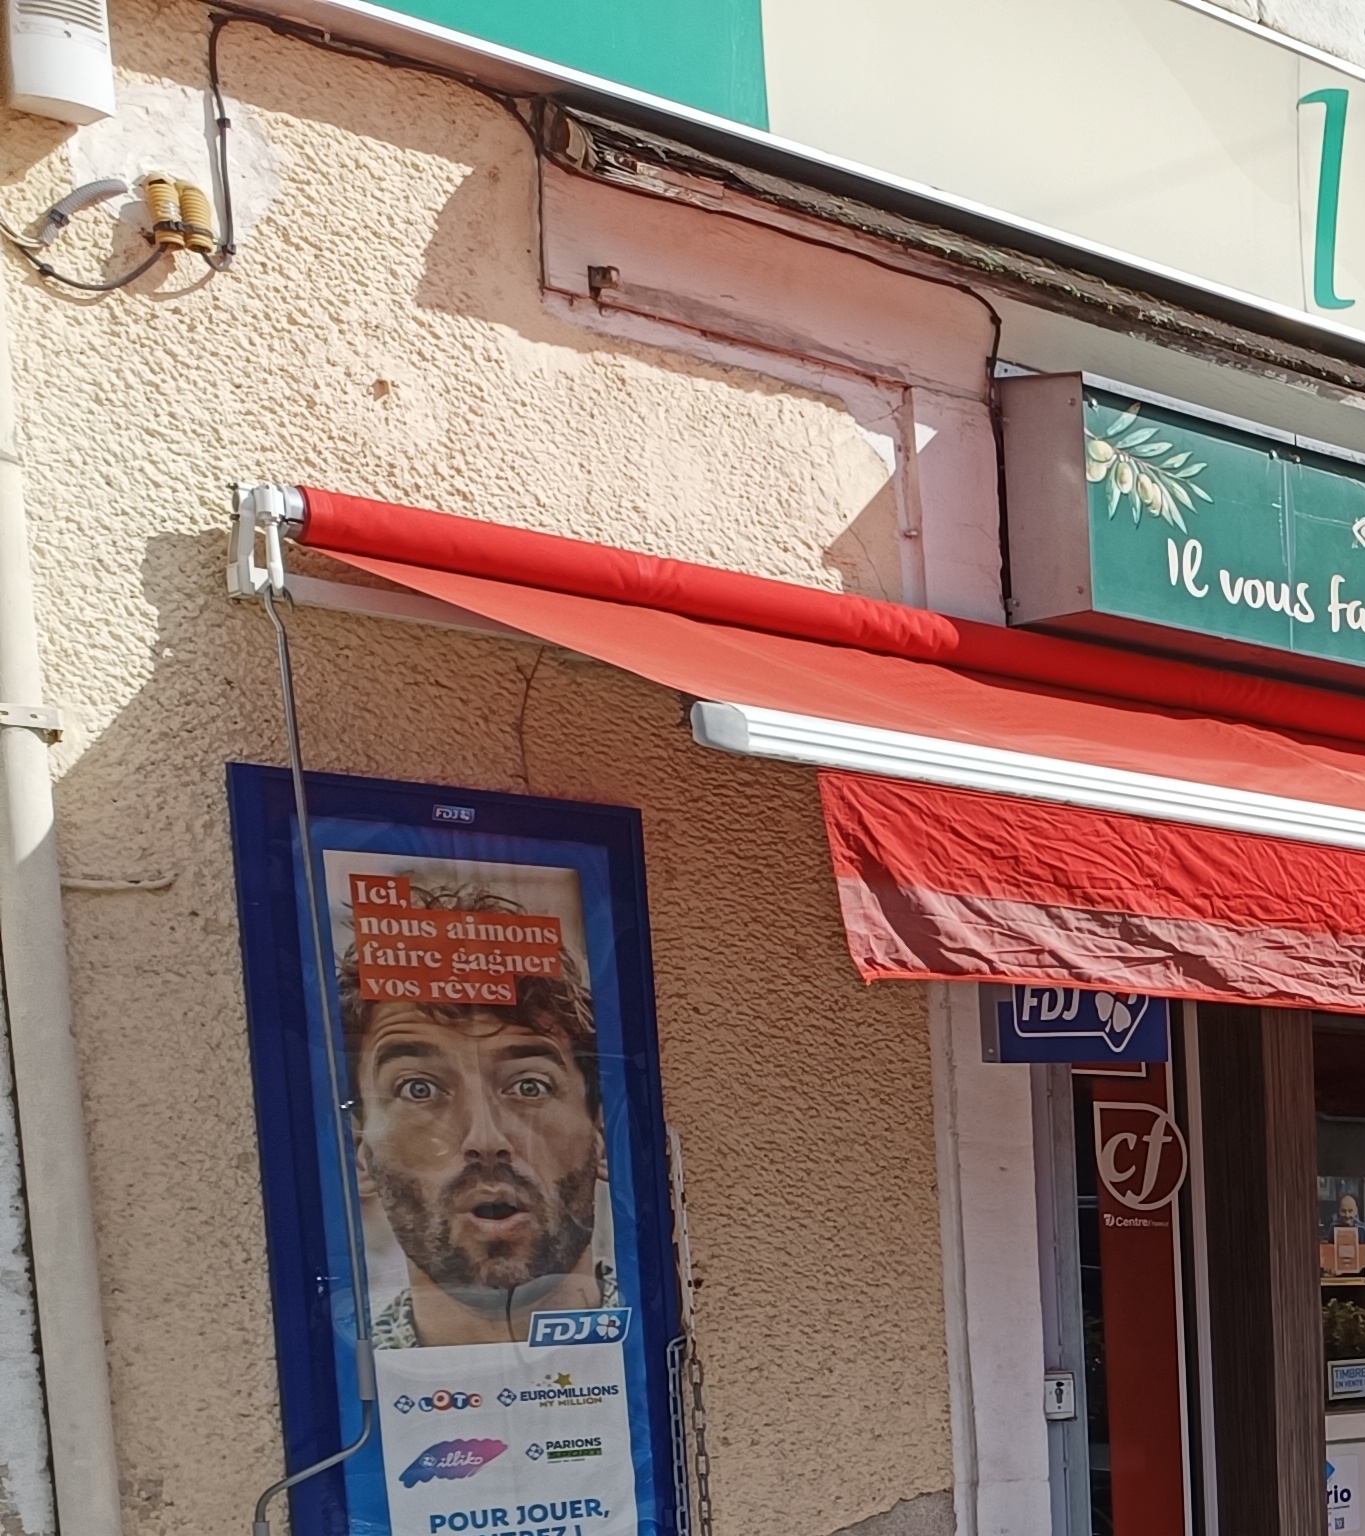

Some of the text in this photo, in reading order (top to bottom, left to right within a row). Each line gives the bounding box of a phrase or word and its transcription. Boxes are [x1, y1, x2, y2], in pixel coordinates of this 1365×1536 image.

[1167, 538, 1208, 598] Il
[1220, 569, 1315, 623] vous
[436, 808, 458, 819] FDJ
[355, 880, 407, 909] Ici,
[360, 915, 558, 945] nous aimons
[362, 942, 556, 975] faire gagner
[366, 976, 512, 1001] vos rêves
[1022, 985, 1080, 1021] FDJ
[1116, 1216, 1148, 1227] Centre
[535, 1317, 593, 1342] FDJ
[1335, 1380, 1344, 1388] EN
[1345, 1379, 1363, 1387] VENTE
[419, 1384, 619, 1412] LOTO EUROMILLIONS
[539, 1397, 602, 1408] MY MILLION
[436, 1437, 602, 1469] illiko PARIONS
[430, 1499, 610, 1534] POUR JOUER,
